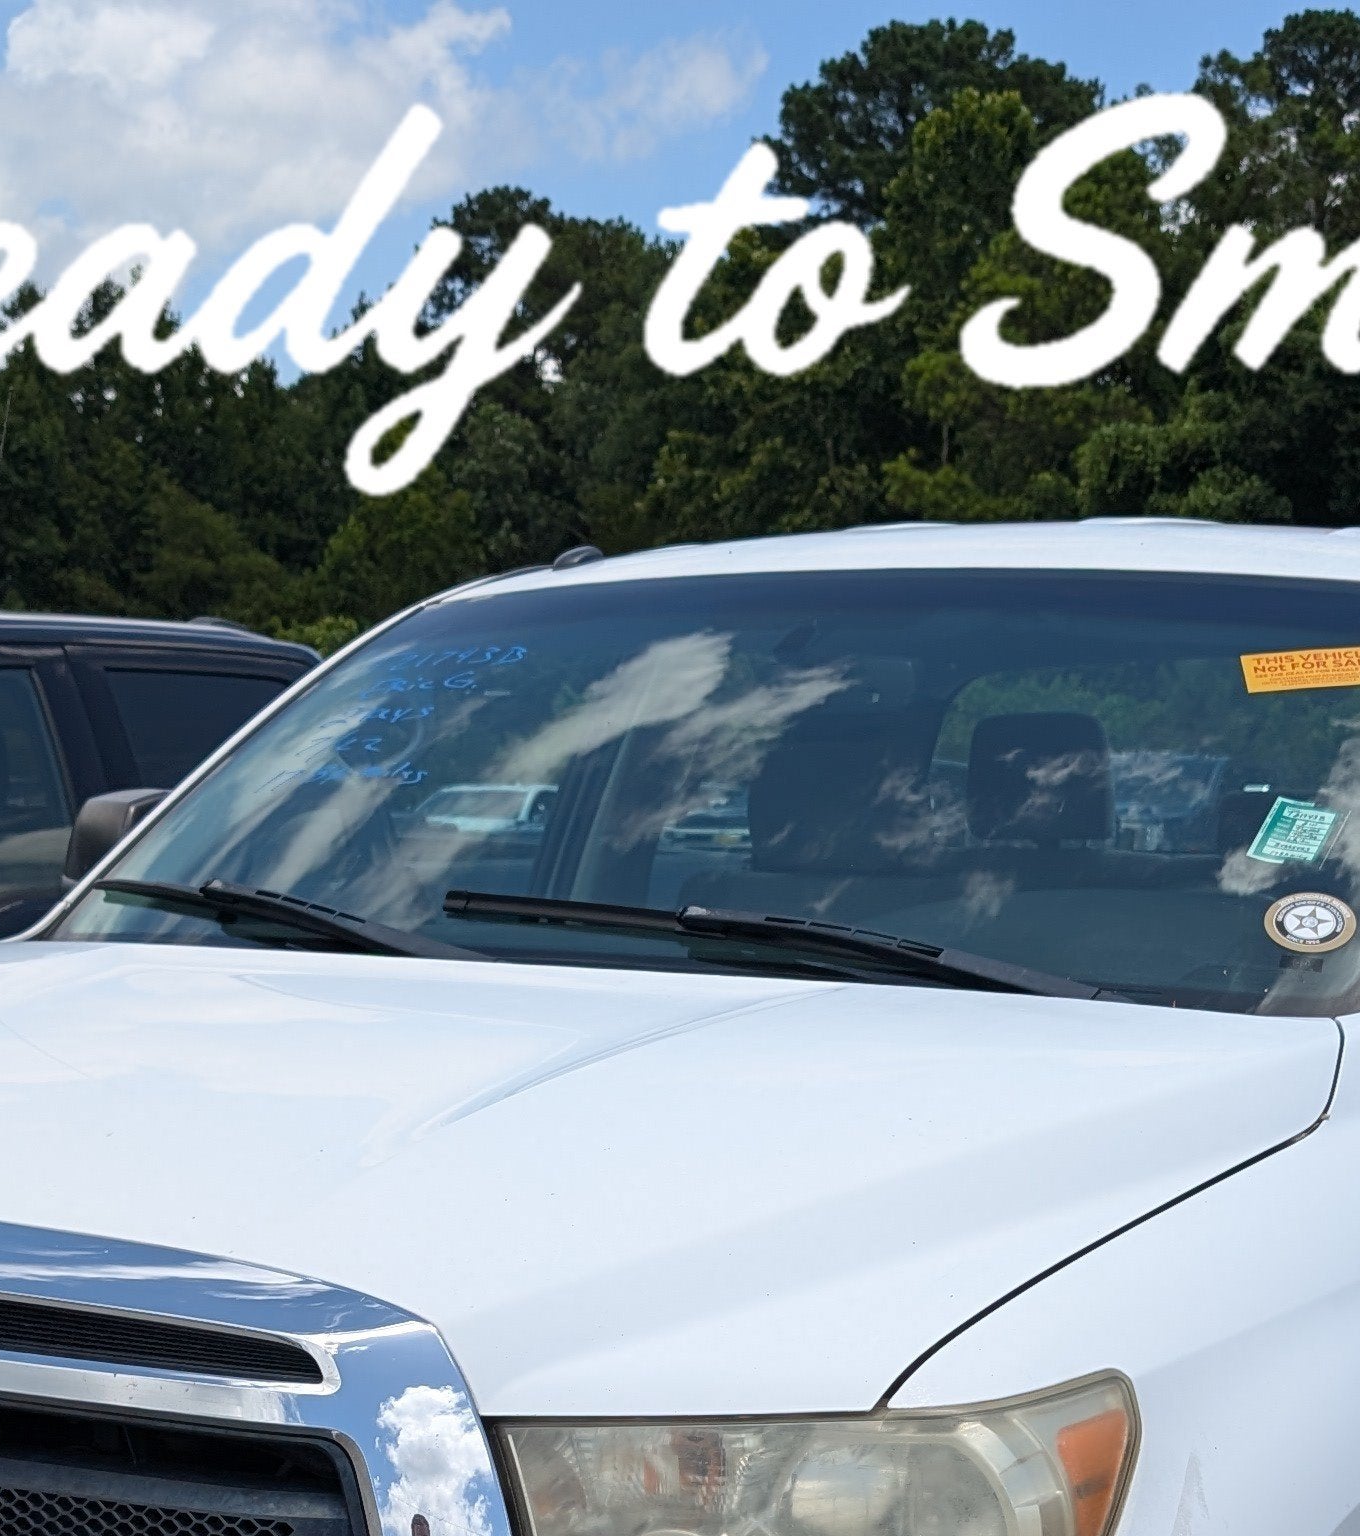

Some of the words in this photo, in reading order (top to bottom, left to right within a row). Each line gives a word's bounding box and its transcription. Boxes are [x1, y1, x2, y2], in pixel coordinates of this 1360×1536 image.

[1252, 655, 1295, 666] THIS
[1253, 664, 1287, 674] Not
[1291, 661, 1328, 671] FOR
